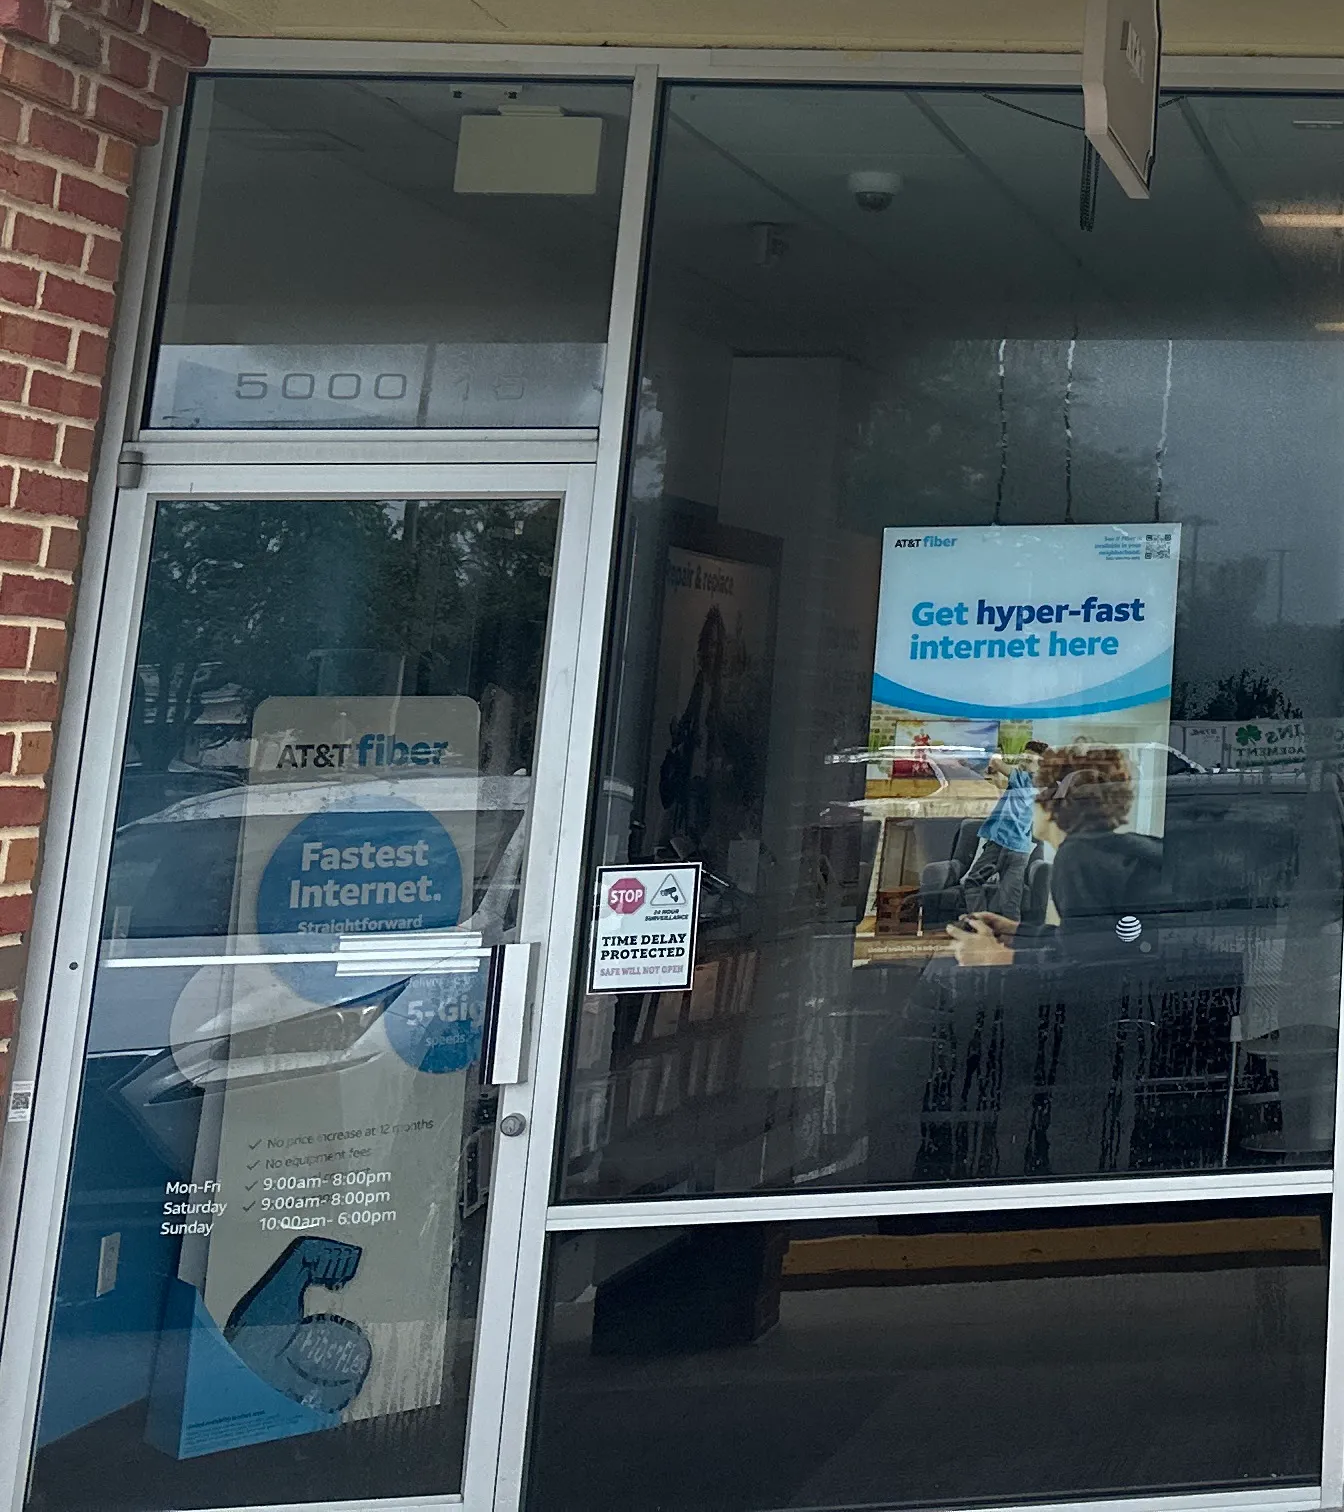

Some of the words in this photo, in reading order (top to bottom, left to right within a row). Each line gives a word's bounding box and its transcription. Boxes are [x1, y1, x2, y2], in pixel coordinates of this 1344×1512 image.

[235, 372, 408, 401] 5000
[894, 538, 922, 549] AT&T
[923, 535, 958, 548] fiber
[911, 600, 969, 627] Get
[976, 596, 1146, 632] hyper-fast
[909, 633, 1041, 660] internet
[1048, 630, 1120, 657] here
[276, 743, 352, 769] AT&T
[357, 732, 450, 767] fiber
[301, 839, 430, 872] Fastest
[289, 875, 442, 909] Internet.
[610, 889, 643, 904] STOP
[298, 914, 424, 934] Straightforward
[602, 935, 638, 946] TIME
[641, 933, 687, 944] DELAY
[600, 947, 685, 961] PROTECTED
[599, 967, 621, 977] SAFE
[622, 966, 642, 976] WILL
[642, 965, 661, 975] NOT
[662, 964, 684, 974] OPEN
[266, 1138, 284, 1149] No
[364, 1126, 377, 1137] at
[379, 1124, 390, 1135] 12
[265, 1158, 282, 1170] No
[284, 1148, 347, 1169] equipment
[165, 1180, 222, 1195] Mon-Fri
[332, 1171, 392, 1187] 8:00pm
[162, 1201, 228, 1216] Saturday
[330, 1191, 391, 1207] 8:00pm
[160, 1221, 214, 1237] Sunday
[337, 1210, 397, 1226] 6:00pm
